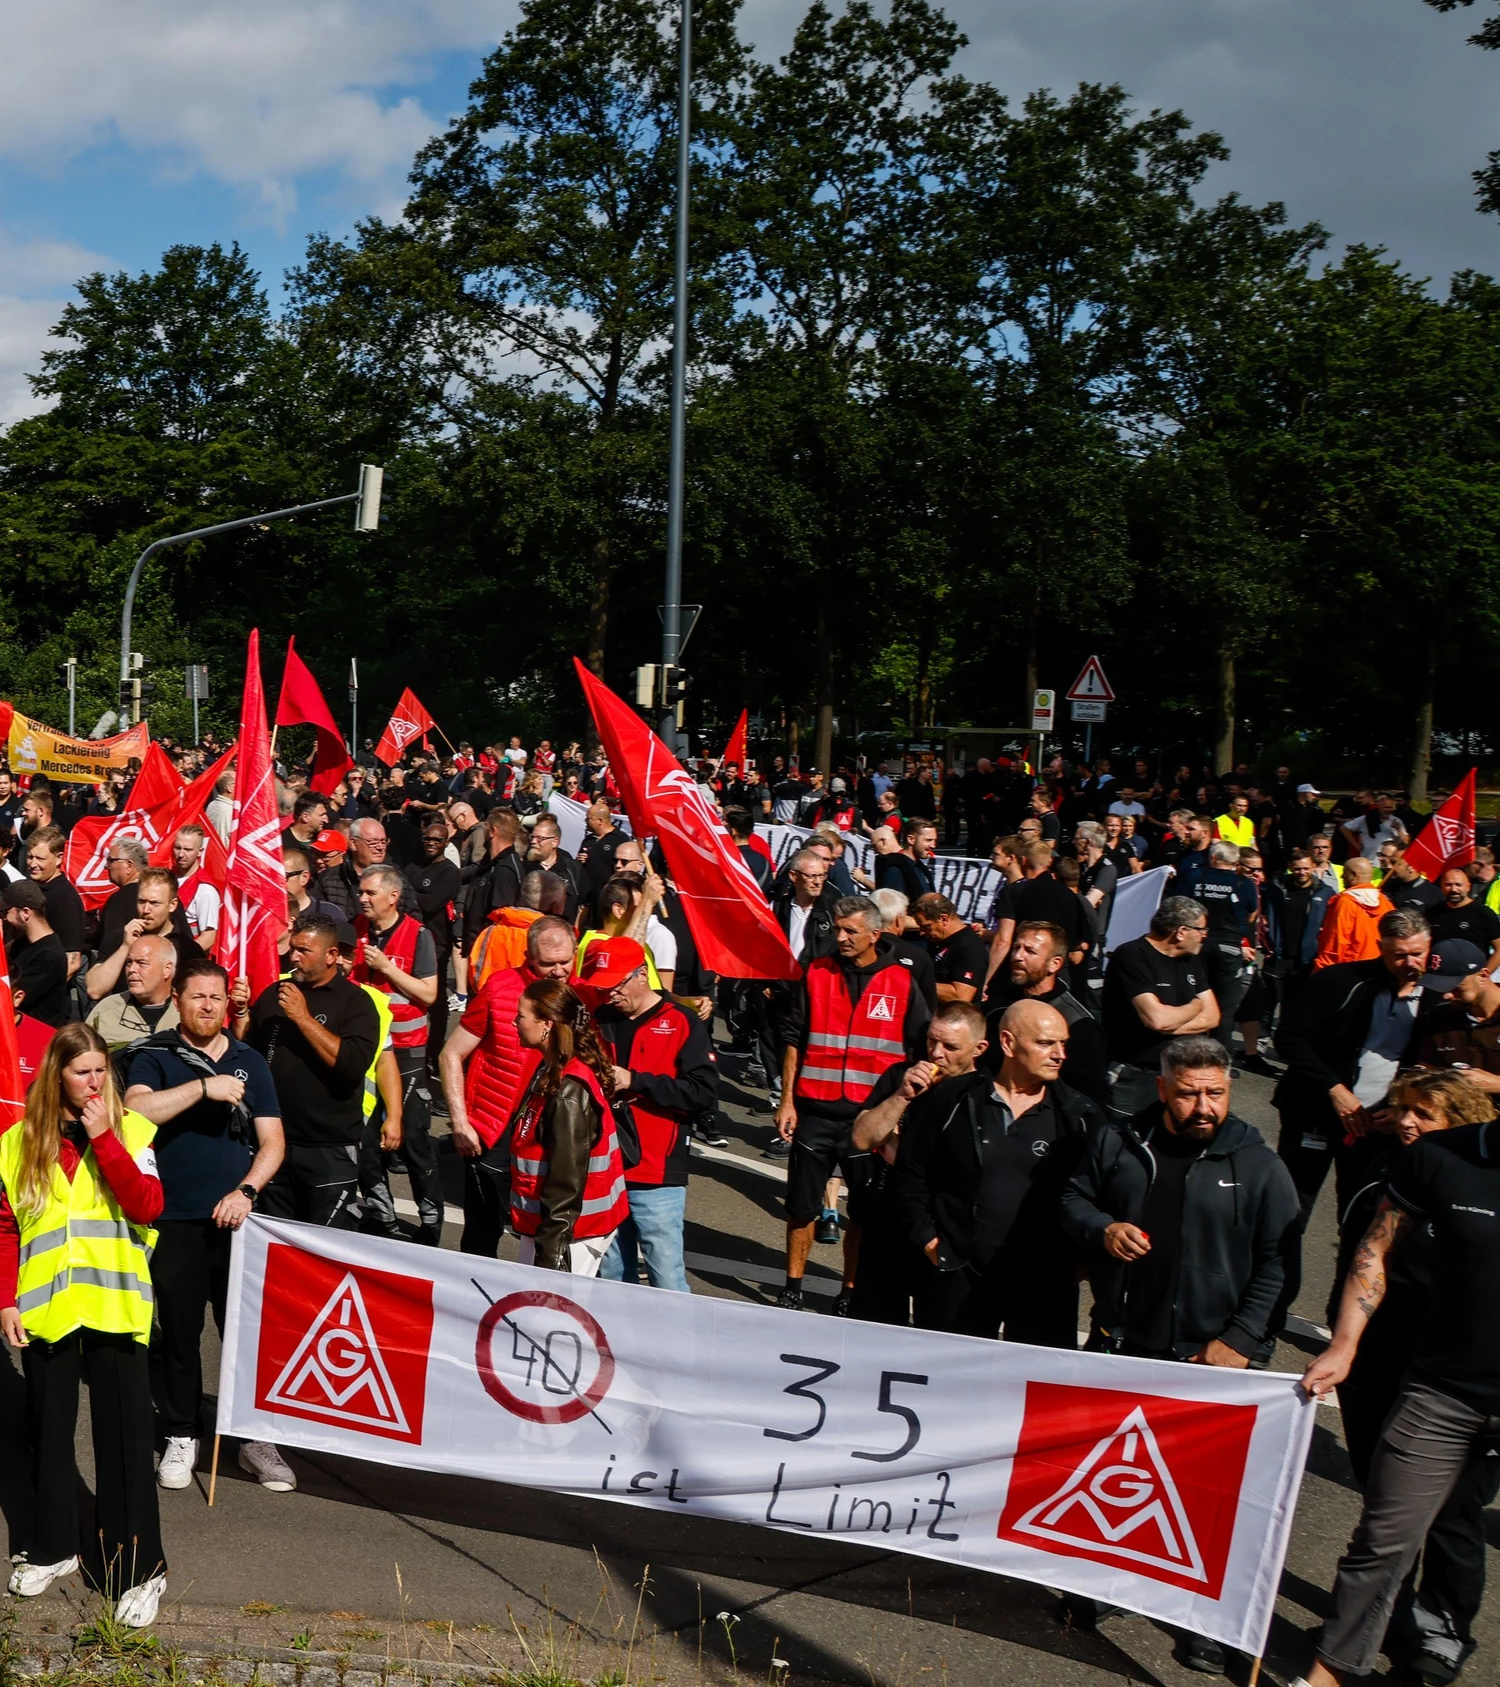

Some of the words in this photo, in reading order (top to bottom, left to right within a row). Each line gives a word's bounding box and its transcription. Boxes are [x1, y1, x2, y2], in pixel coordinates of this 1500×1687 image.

[41, 759, 92, 775] Mercedes
[54, 742, 111, 758] Lackierung
[512, 1321, 582, 1395] 40
[601, 1453, 688, 1504] ist
[765, 1462, 960, 1542] Limit
